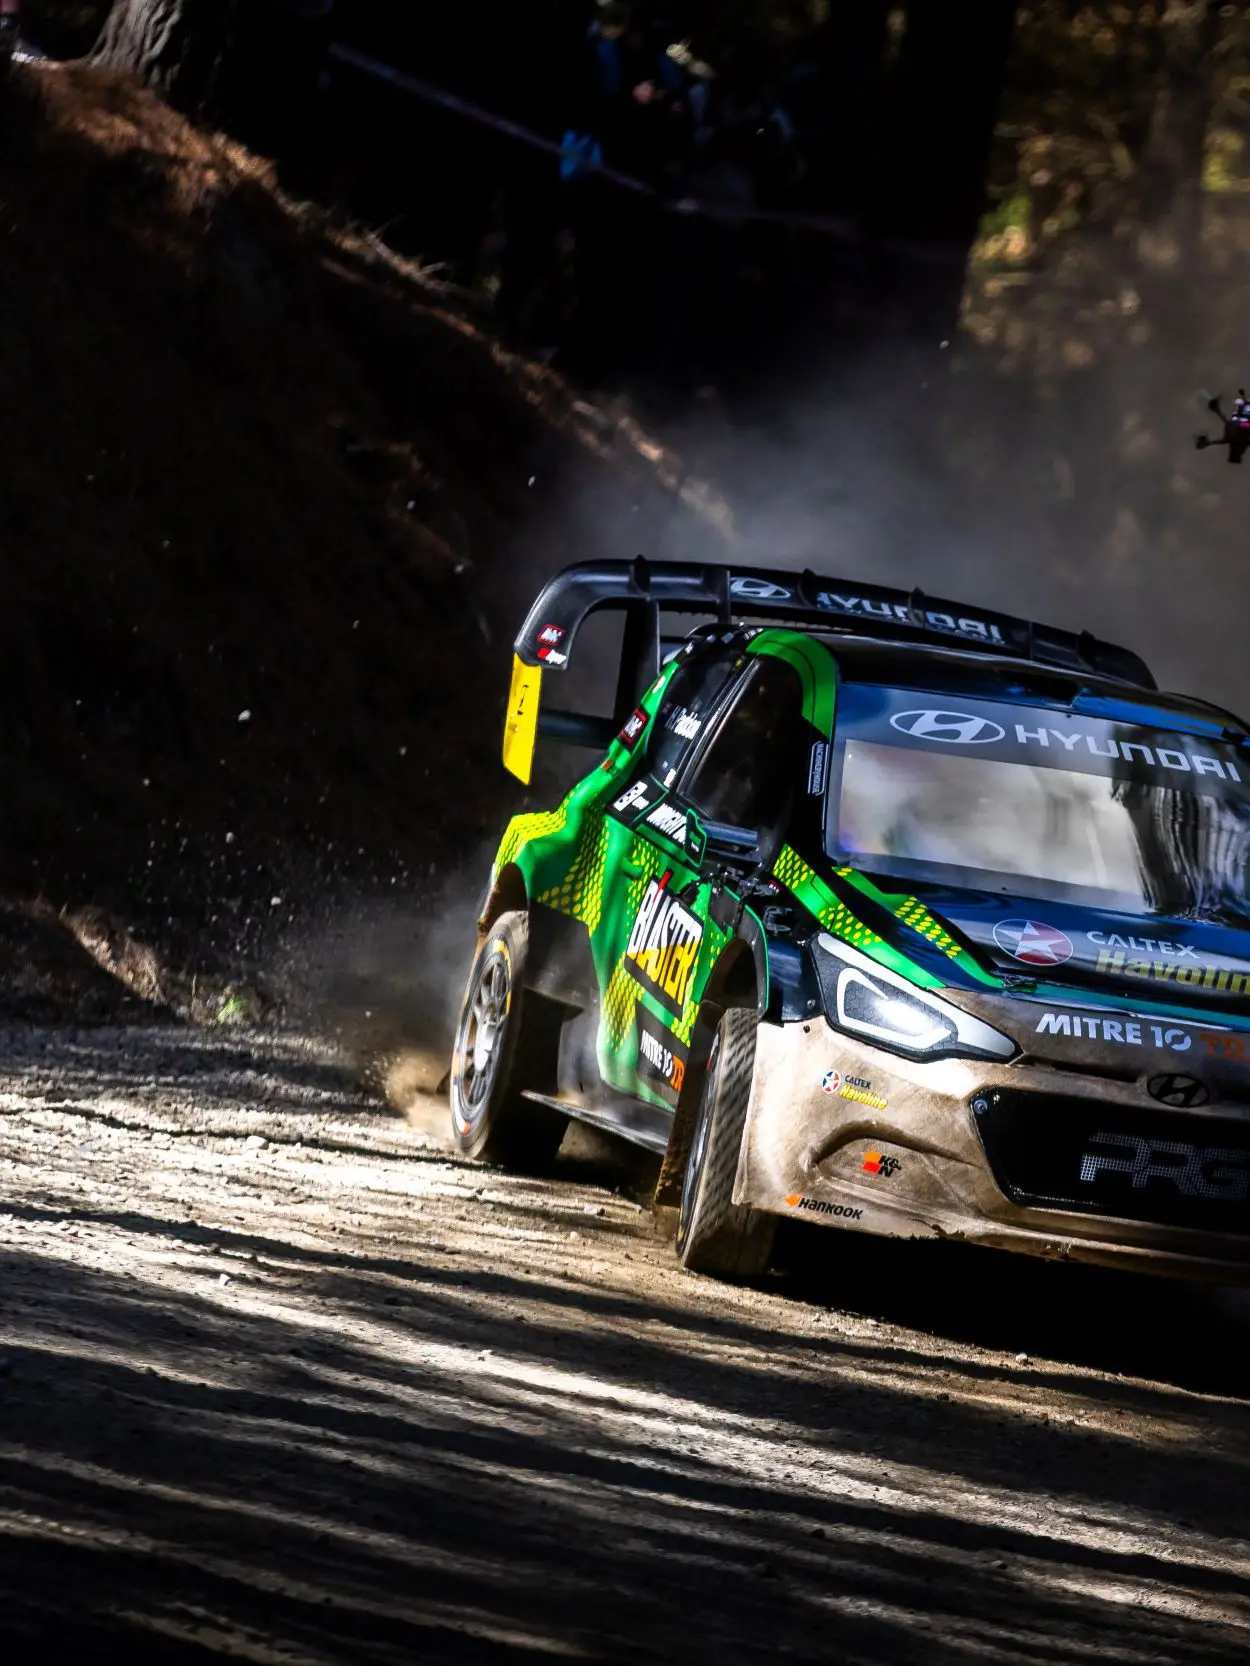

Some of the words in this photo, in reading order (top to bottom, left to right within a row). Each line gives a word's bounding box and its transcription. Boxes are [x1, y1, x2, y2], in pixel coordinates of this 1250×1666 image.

[1015, 724, 1242, 782] HYUNDAI
[626, 870, 703, 1005] BLASTER
[1086, 930, 1200, 959] CALTEX
[1035, 1012, 1143, 1045] MITRE
[1151, 1025, 1192, 1051] 10
[640, 1029, 663, 1070] MITRE
[662, 1048, 673, 1077] 10
[840, 1084, 888, 1109] Havoline
[844, 1075, 872, 1090] CALTEX
